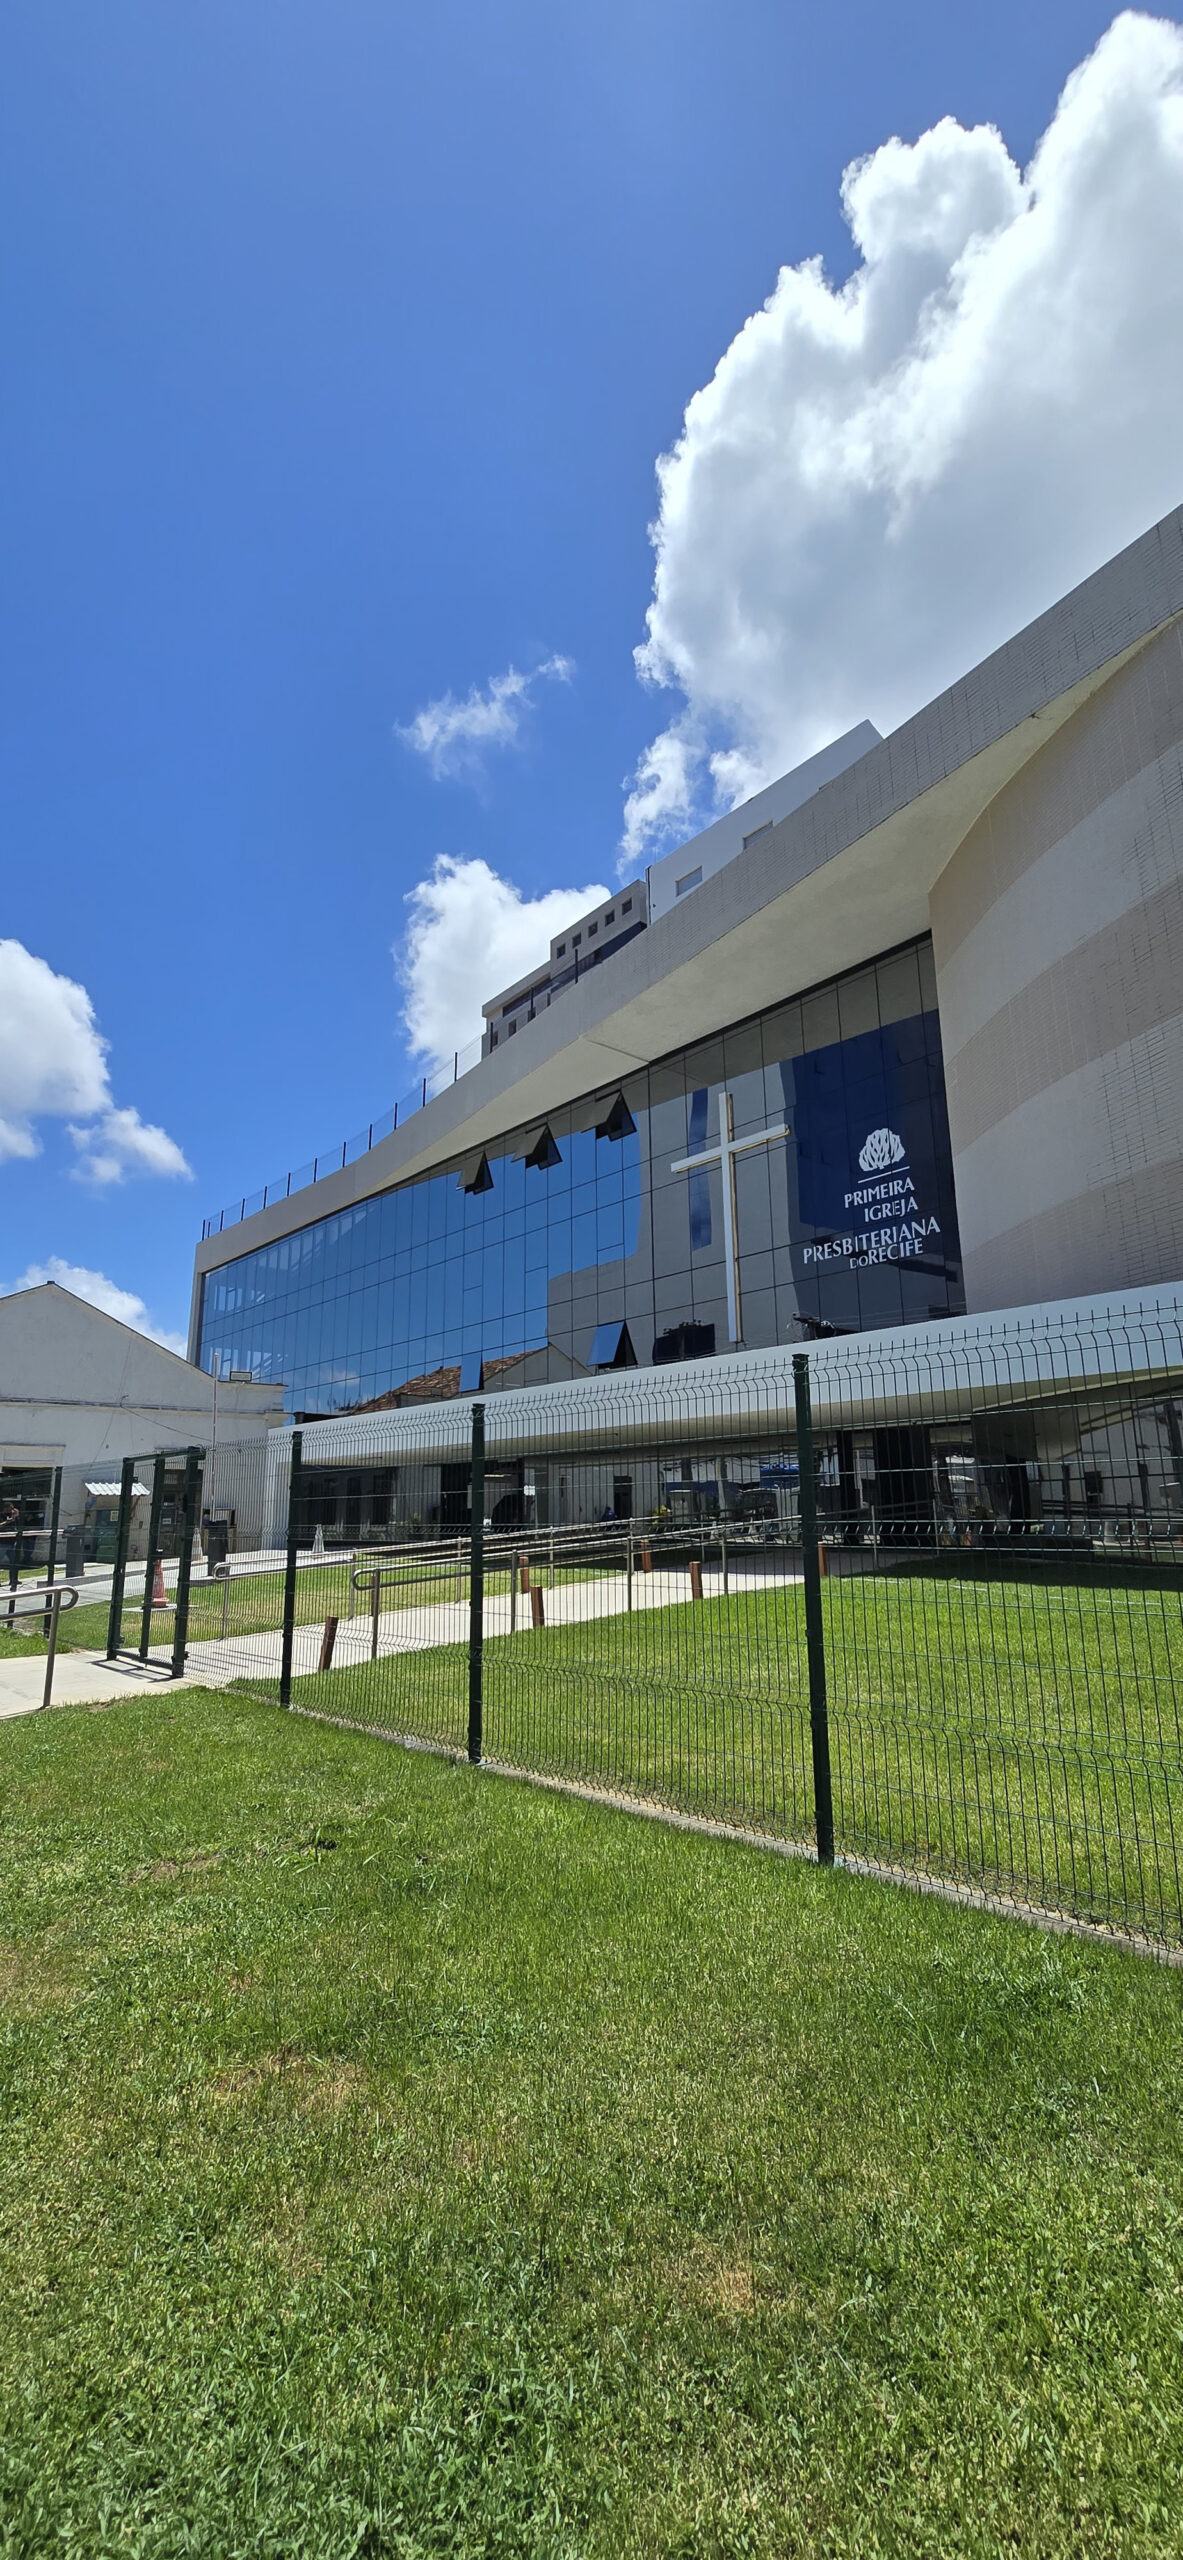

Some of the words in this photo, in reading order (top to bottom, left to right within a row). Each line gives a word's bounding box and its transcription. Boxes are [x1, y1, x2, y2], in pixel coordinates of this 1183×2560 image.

[844, 1177, 915, 1208] PRIMEIRA
[864, 1196, 919, 1222] IGREJA
[803, 1216, 941, 1264] PRESBITERIANA
